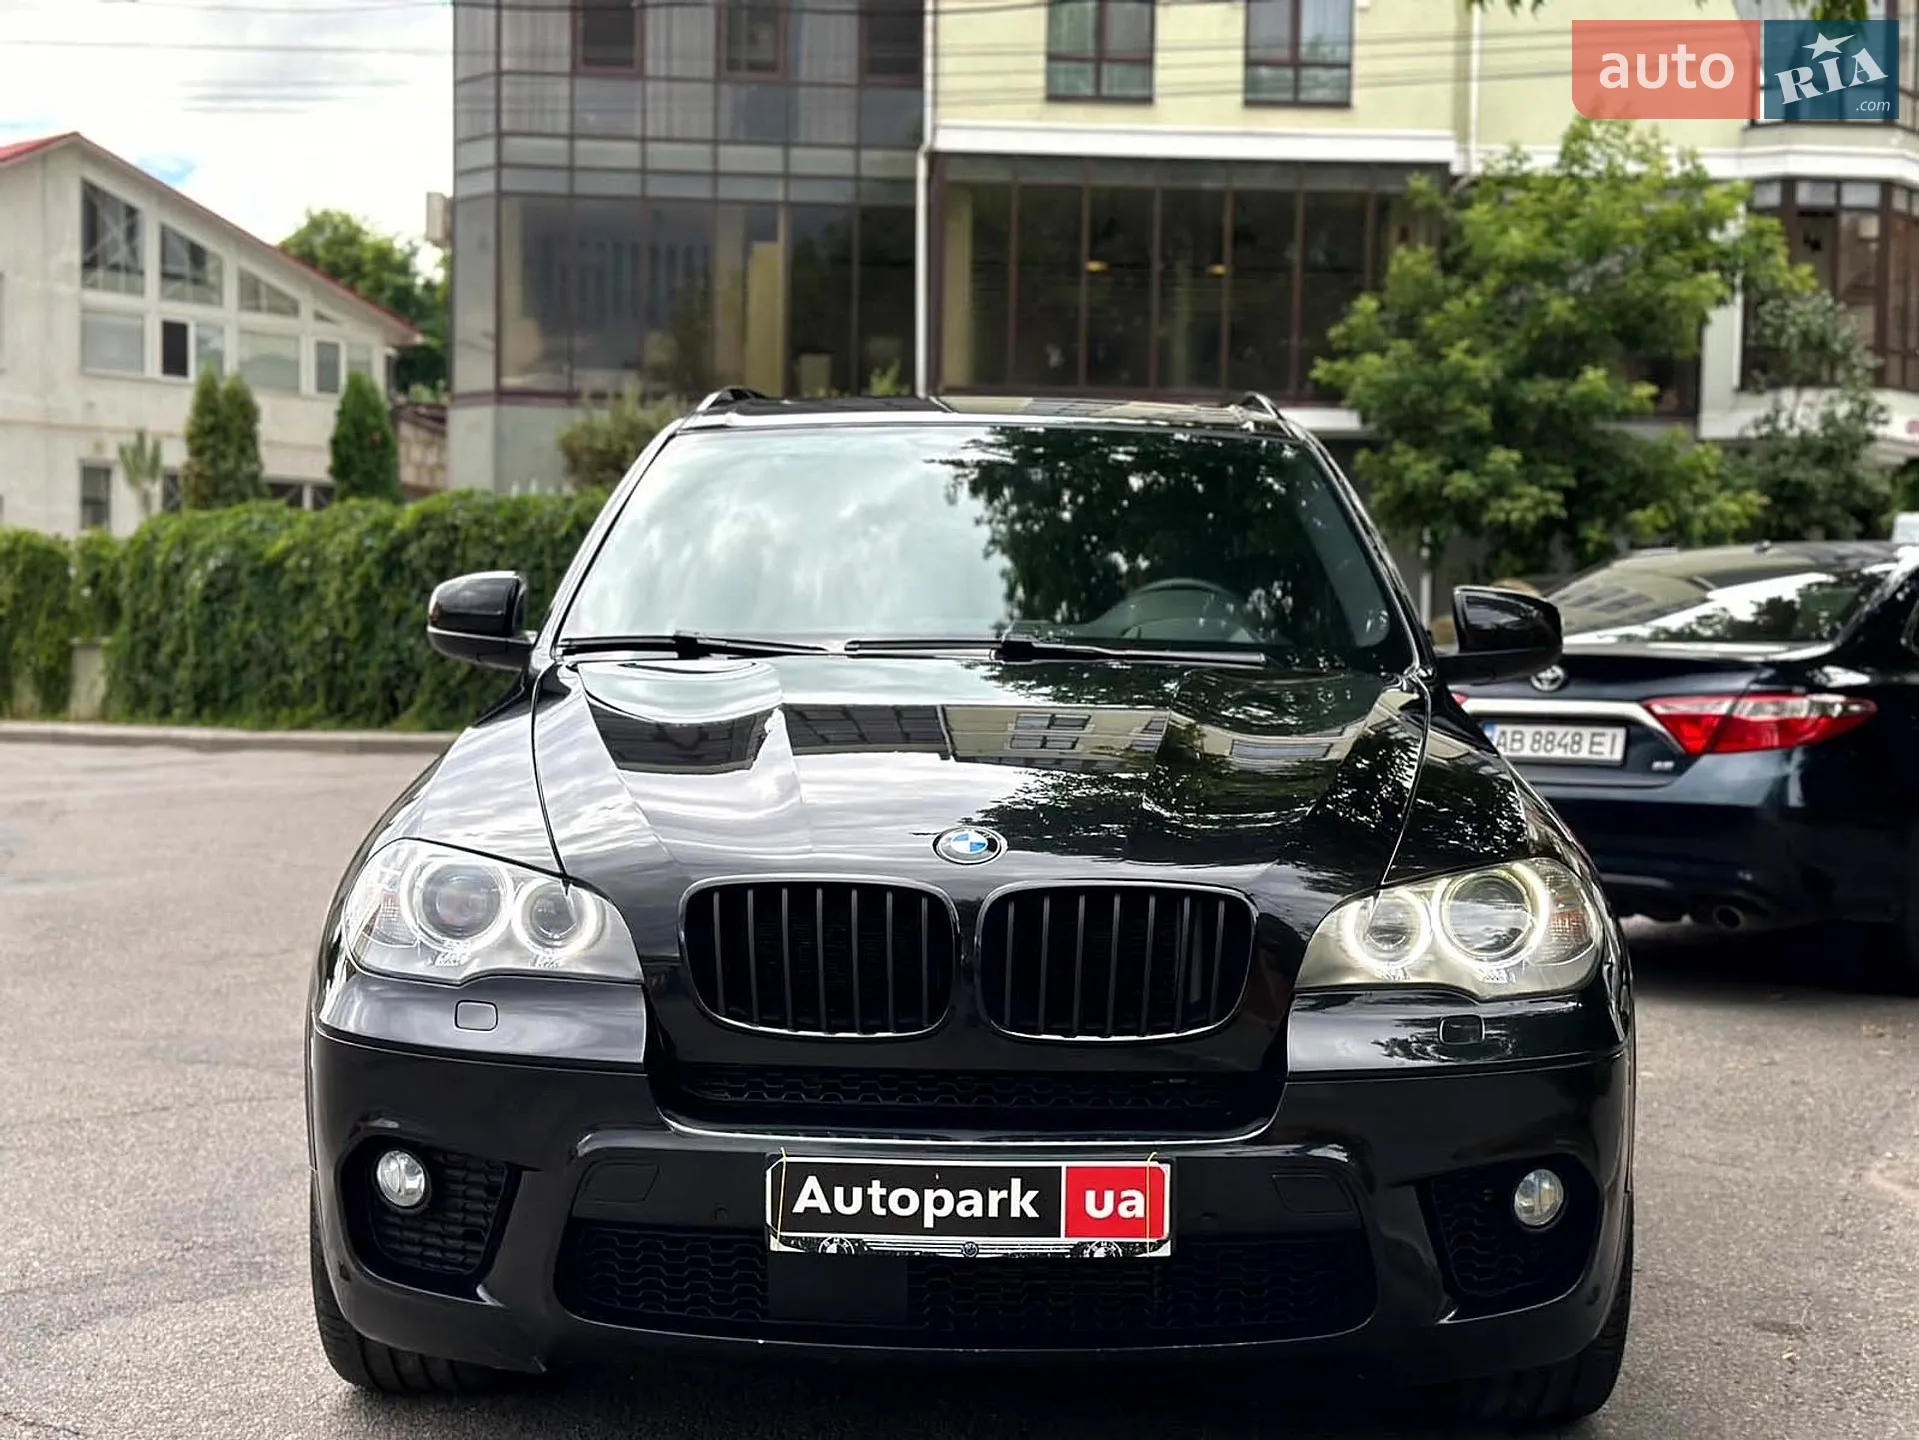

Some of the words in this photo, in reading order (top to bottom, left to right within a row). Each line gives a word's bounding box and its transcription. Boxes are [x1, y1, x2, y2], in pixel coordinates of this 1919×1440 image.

[1496, 730, 1525, 753] AB
[1530, 731, 1583, 754] 8848
[1588, 732, 1617, 756] EI
[792, 1174, 1040, 1228] Autopark
[1084, 1187, 1146, 1219] ua
